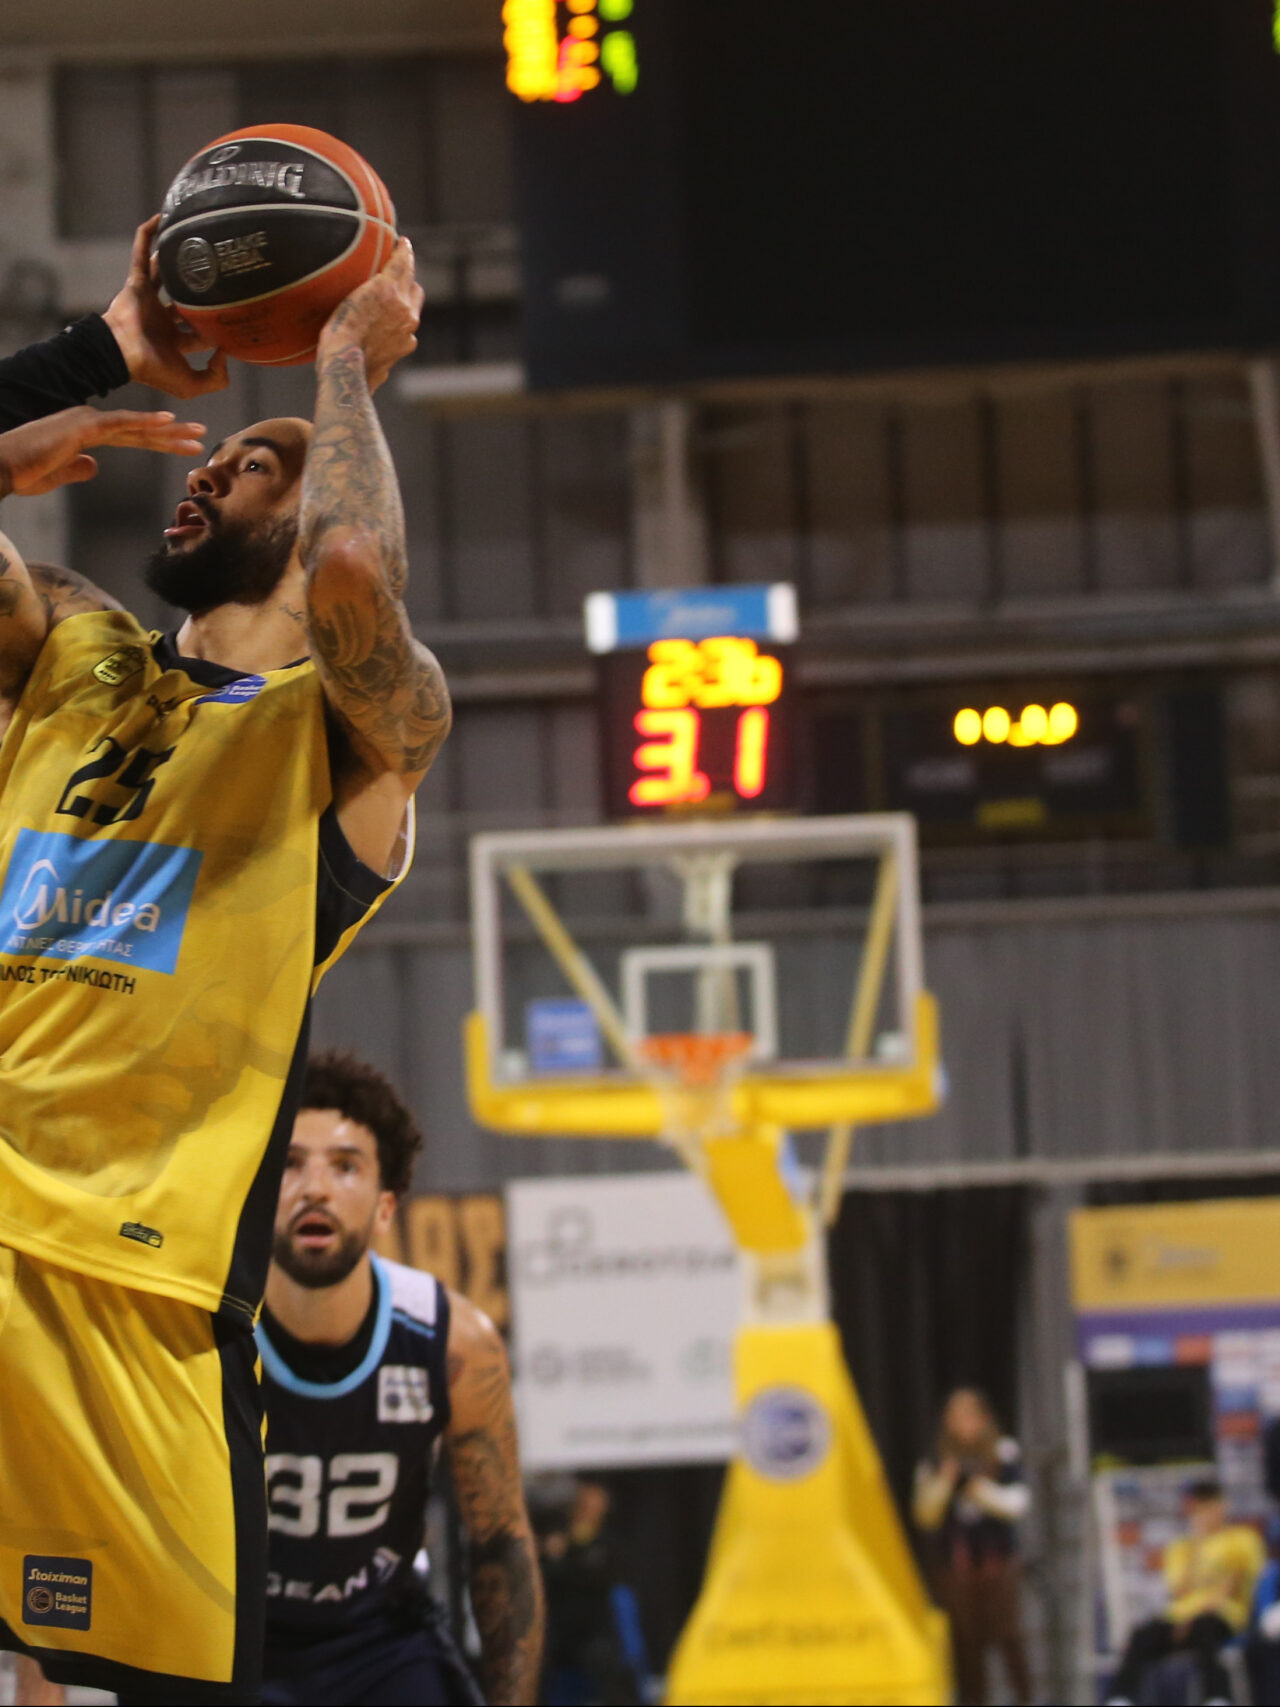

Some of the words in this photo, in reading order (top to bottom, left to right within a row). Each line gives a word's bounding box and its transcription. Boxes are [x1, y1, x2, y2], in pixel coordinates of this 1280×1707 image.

[165, 161, 306, 212] PALDING
[54, 736, 177, 825] 25
[13, 859, 161, 932] Midea
[265, 1452, 399, 1538] 32
[28, 1567, 88, 1586] Stoiximan
